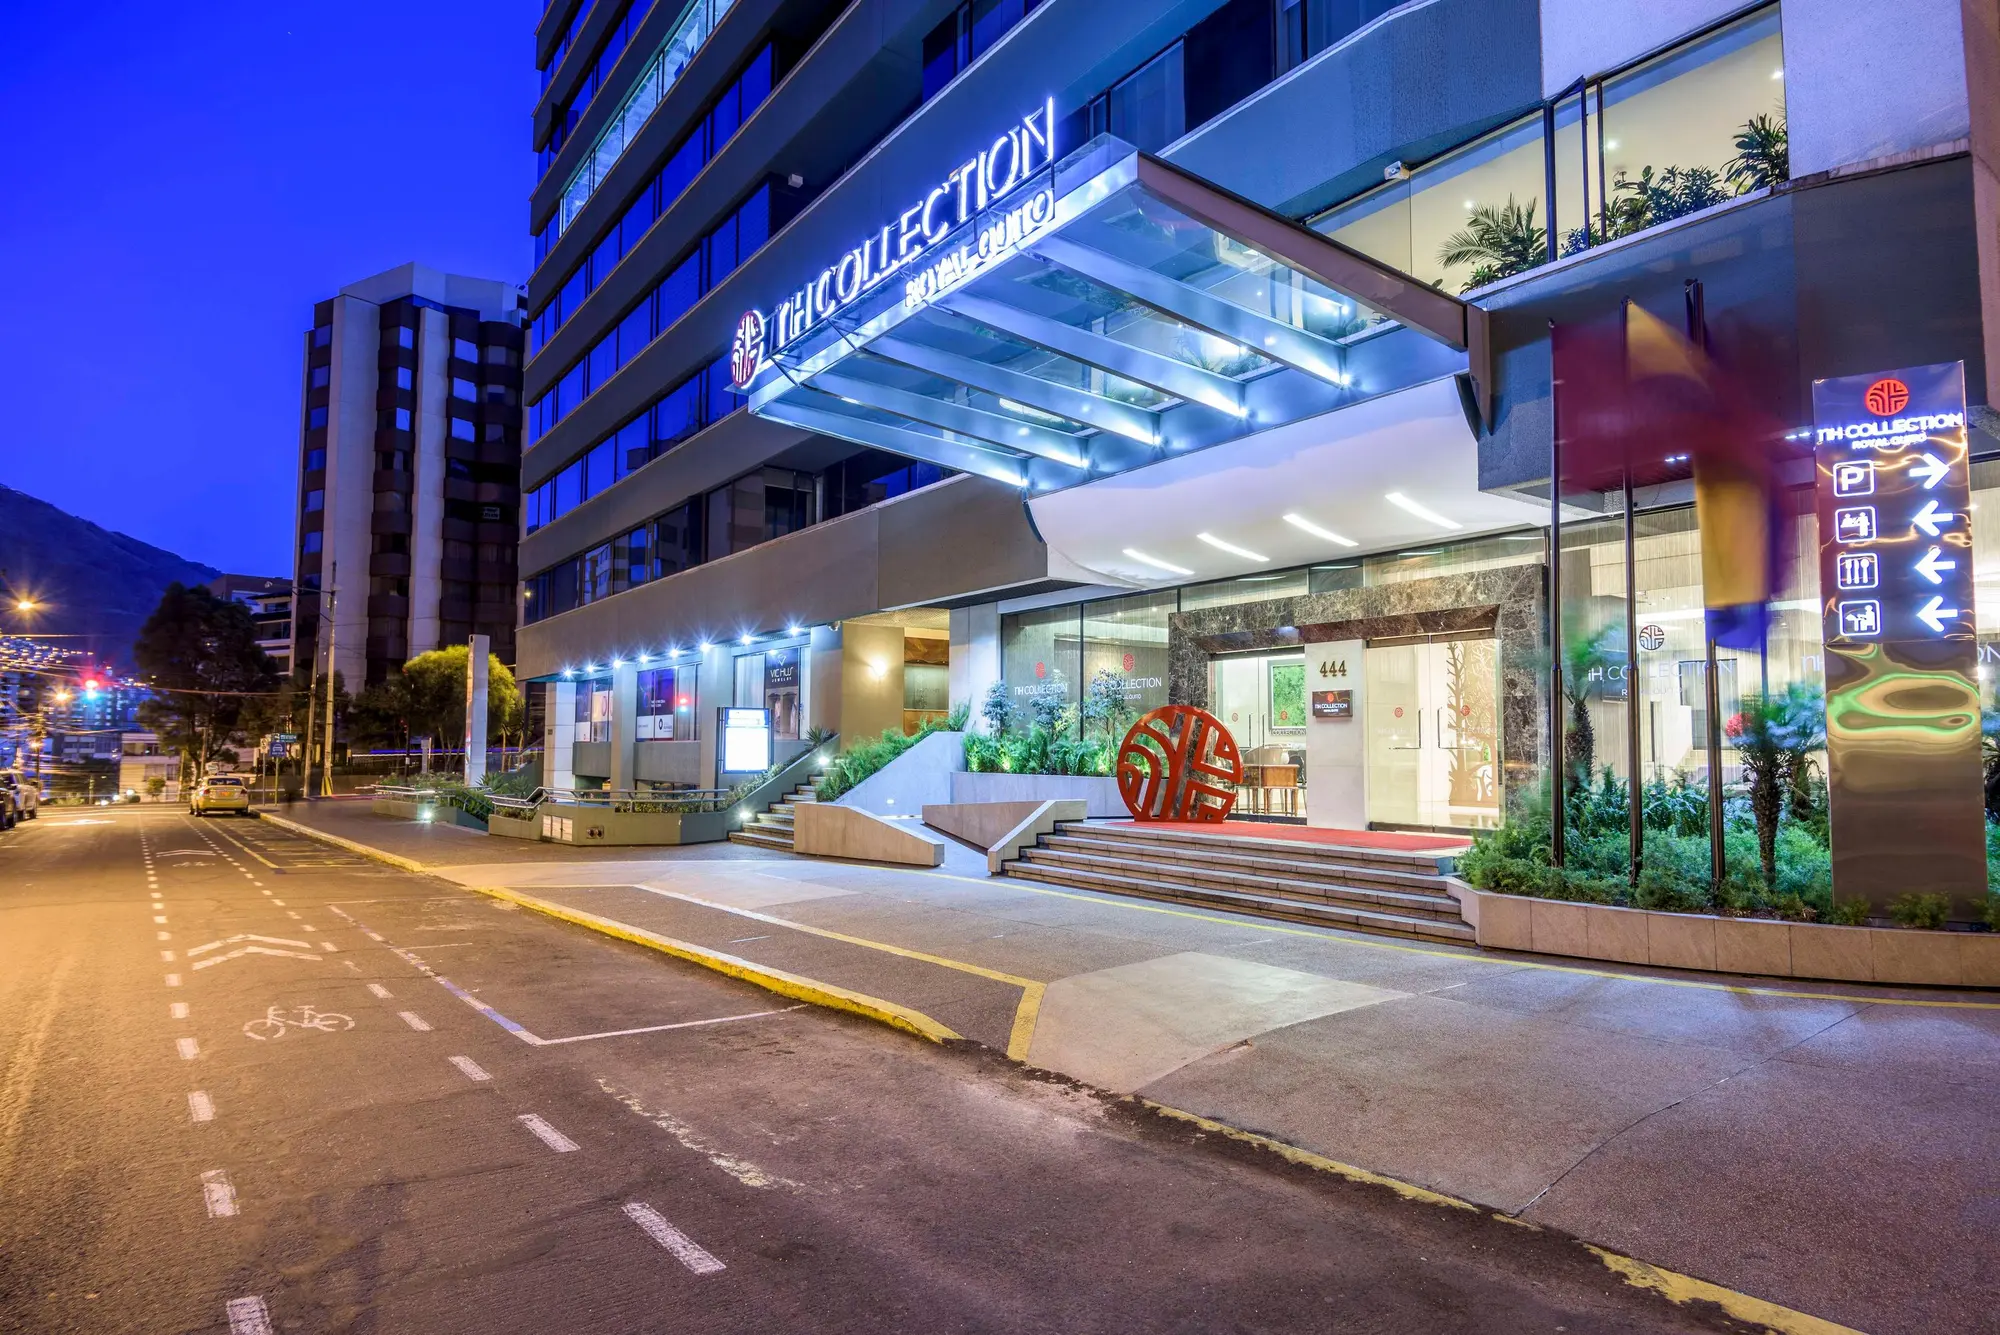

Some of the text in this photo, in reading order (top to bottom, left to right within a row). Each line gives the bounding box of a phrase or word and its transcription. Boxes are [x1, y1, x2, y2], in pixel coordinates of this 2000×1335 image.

[815, 96, 1054, 318] COLLECTION
[1845, 412, 1963, 438] COLLECTION
[1319, 660, 1347, 677] 444
